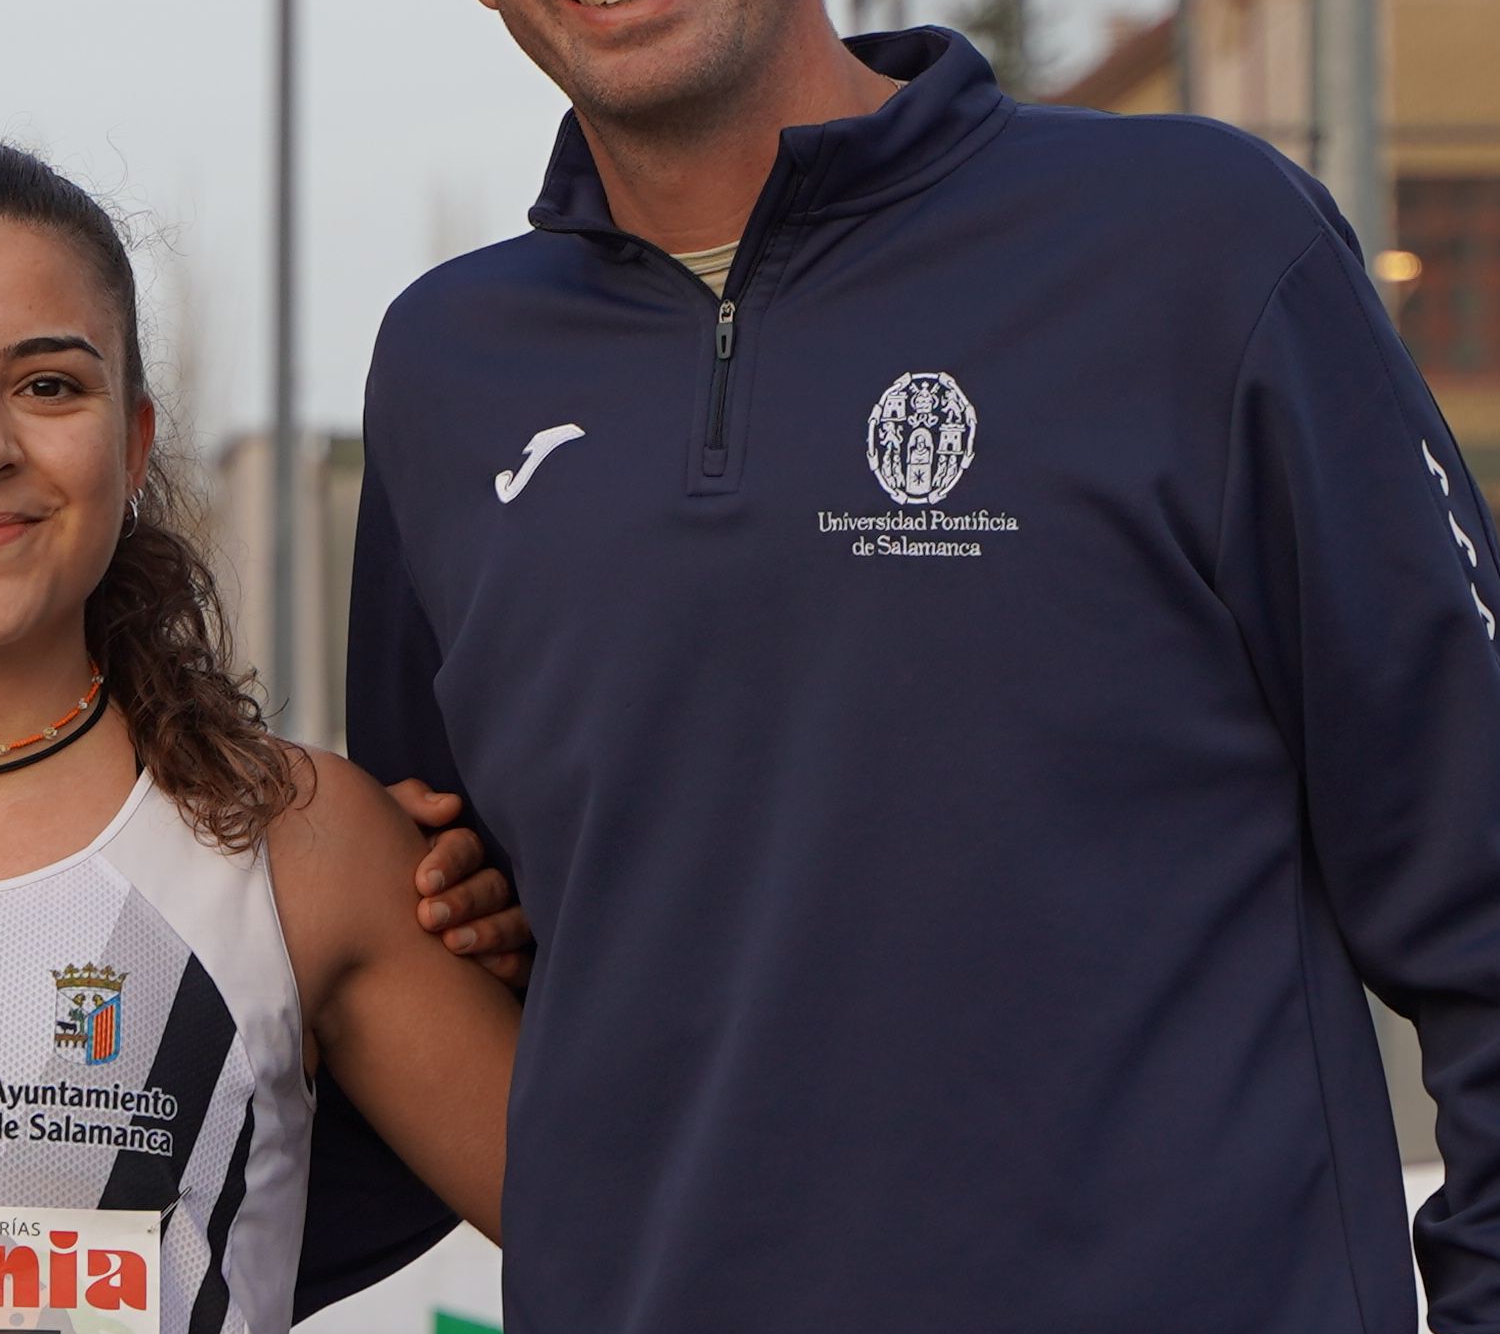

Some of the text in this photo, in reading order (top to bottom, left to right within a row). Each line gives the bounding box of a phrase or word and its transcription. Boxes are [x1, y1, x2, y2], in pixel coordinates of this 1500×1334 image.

[817, 509, 1019, 533] Universidad Pontificia
[852, 534, 982, 557] de Salamanca
[29, 1113, 173, 1157] Salamanca
